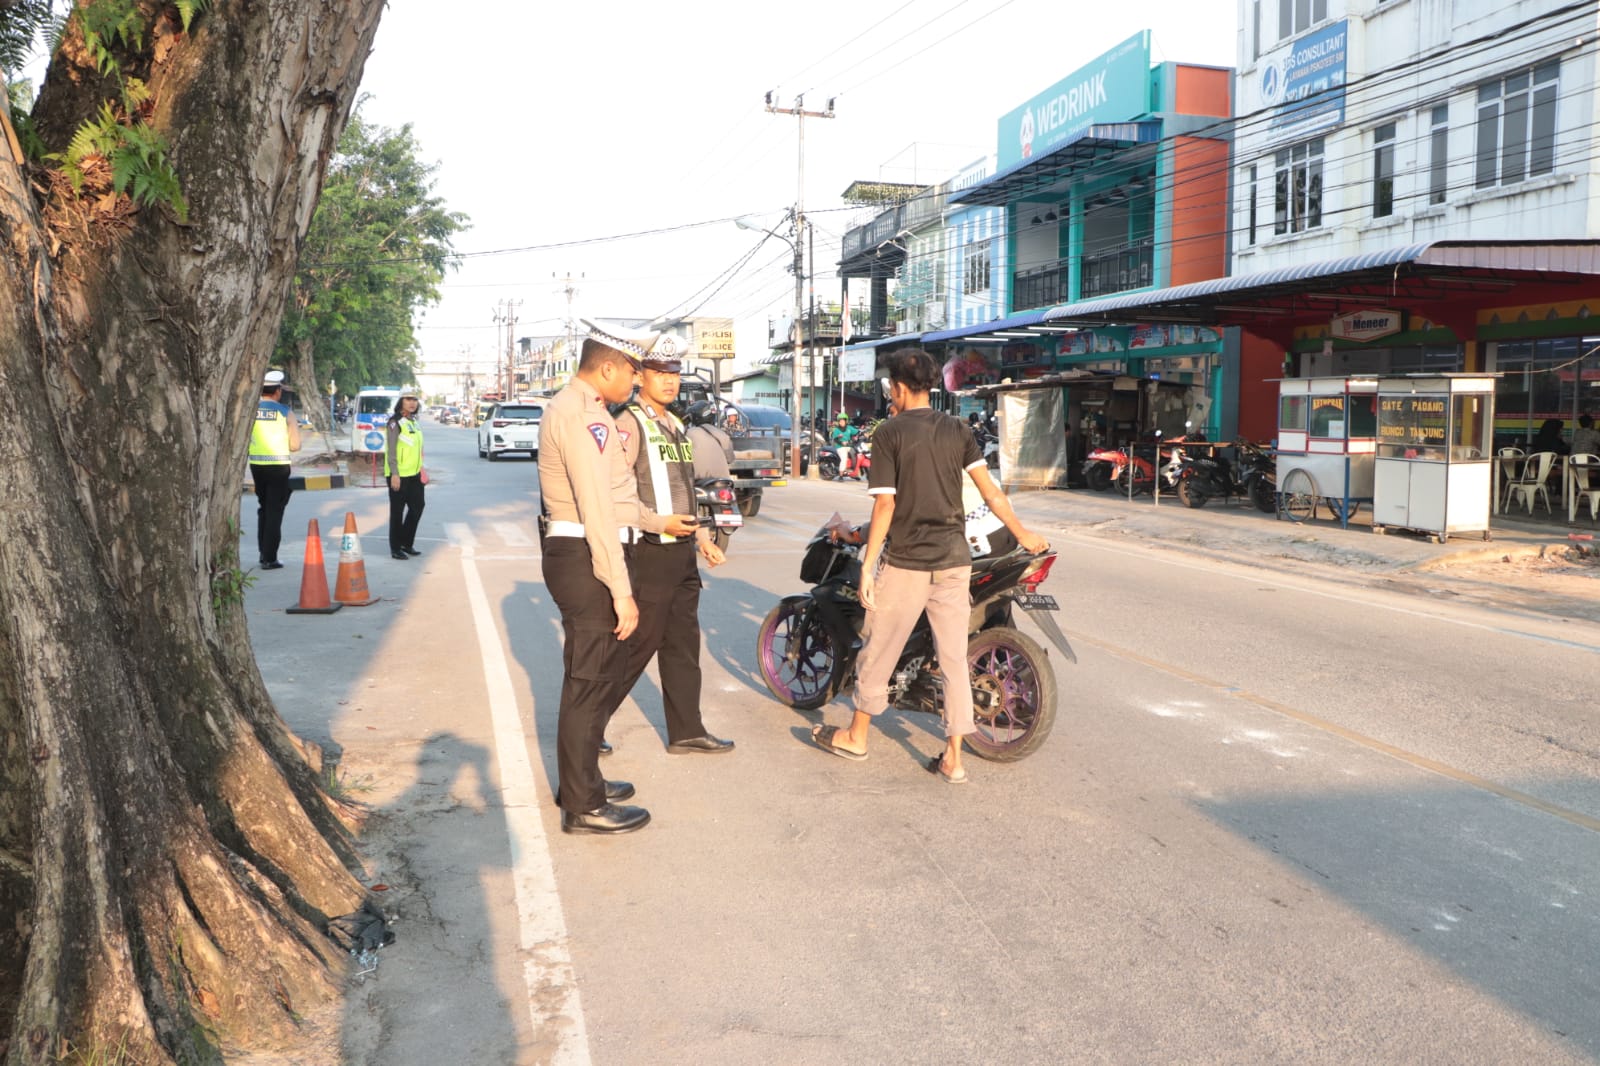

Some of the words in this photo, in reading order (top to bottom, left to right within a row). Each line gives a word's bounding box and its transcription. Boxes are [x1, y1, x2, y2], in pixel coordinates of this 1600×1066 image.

[1297, 33, 1345, 63] CONSULTANT
[1036, 69, 1107, 137] WEDRINK
[1352, 317, 1390, 330] Meneer
[1381, 401, 1403, 411] SATE
[1411, 401, 1444, 412] PADANG
